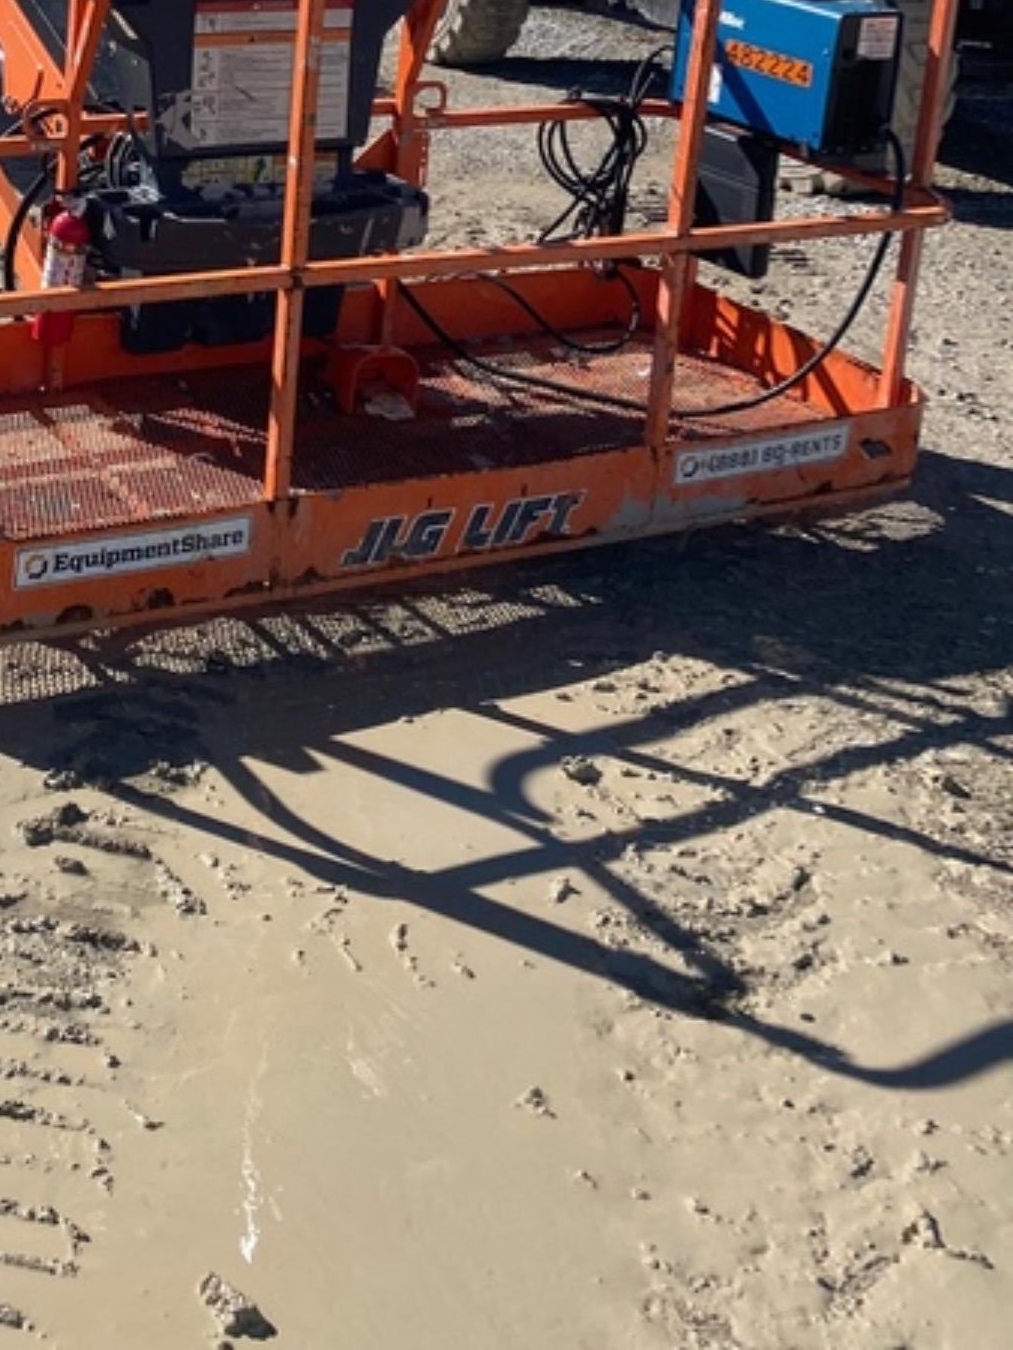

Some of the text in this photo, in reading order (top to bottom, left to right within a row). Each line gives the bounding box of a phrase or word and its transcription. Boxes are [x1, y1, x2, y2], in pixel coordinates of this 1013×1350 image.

[53, 529, 243, 573] EquipmentShare
[340, 489, 587, 568] JLG LIFT
